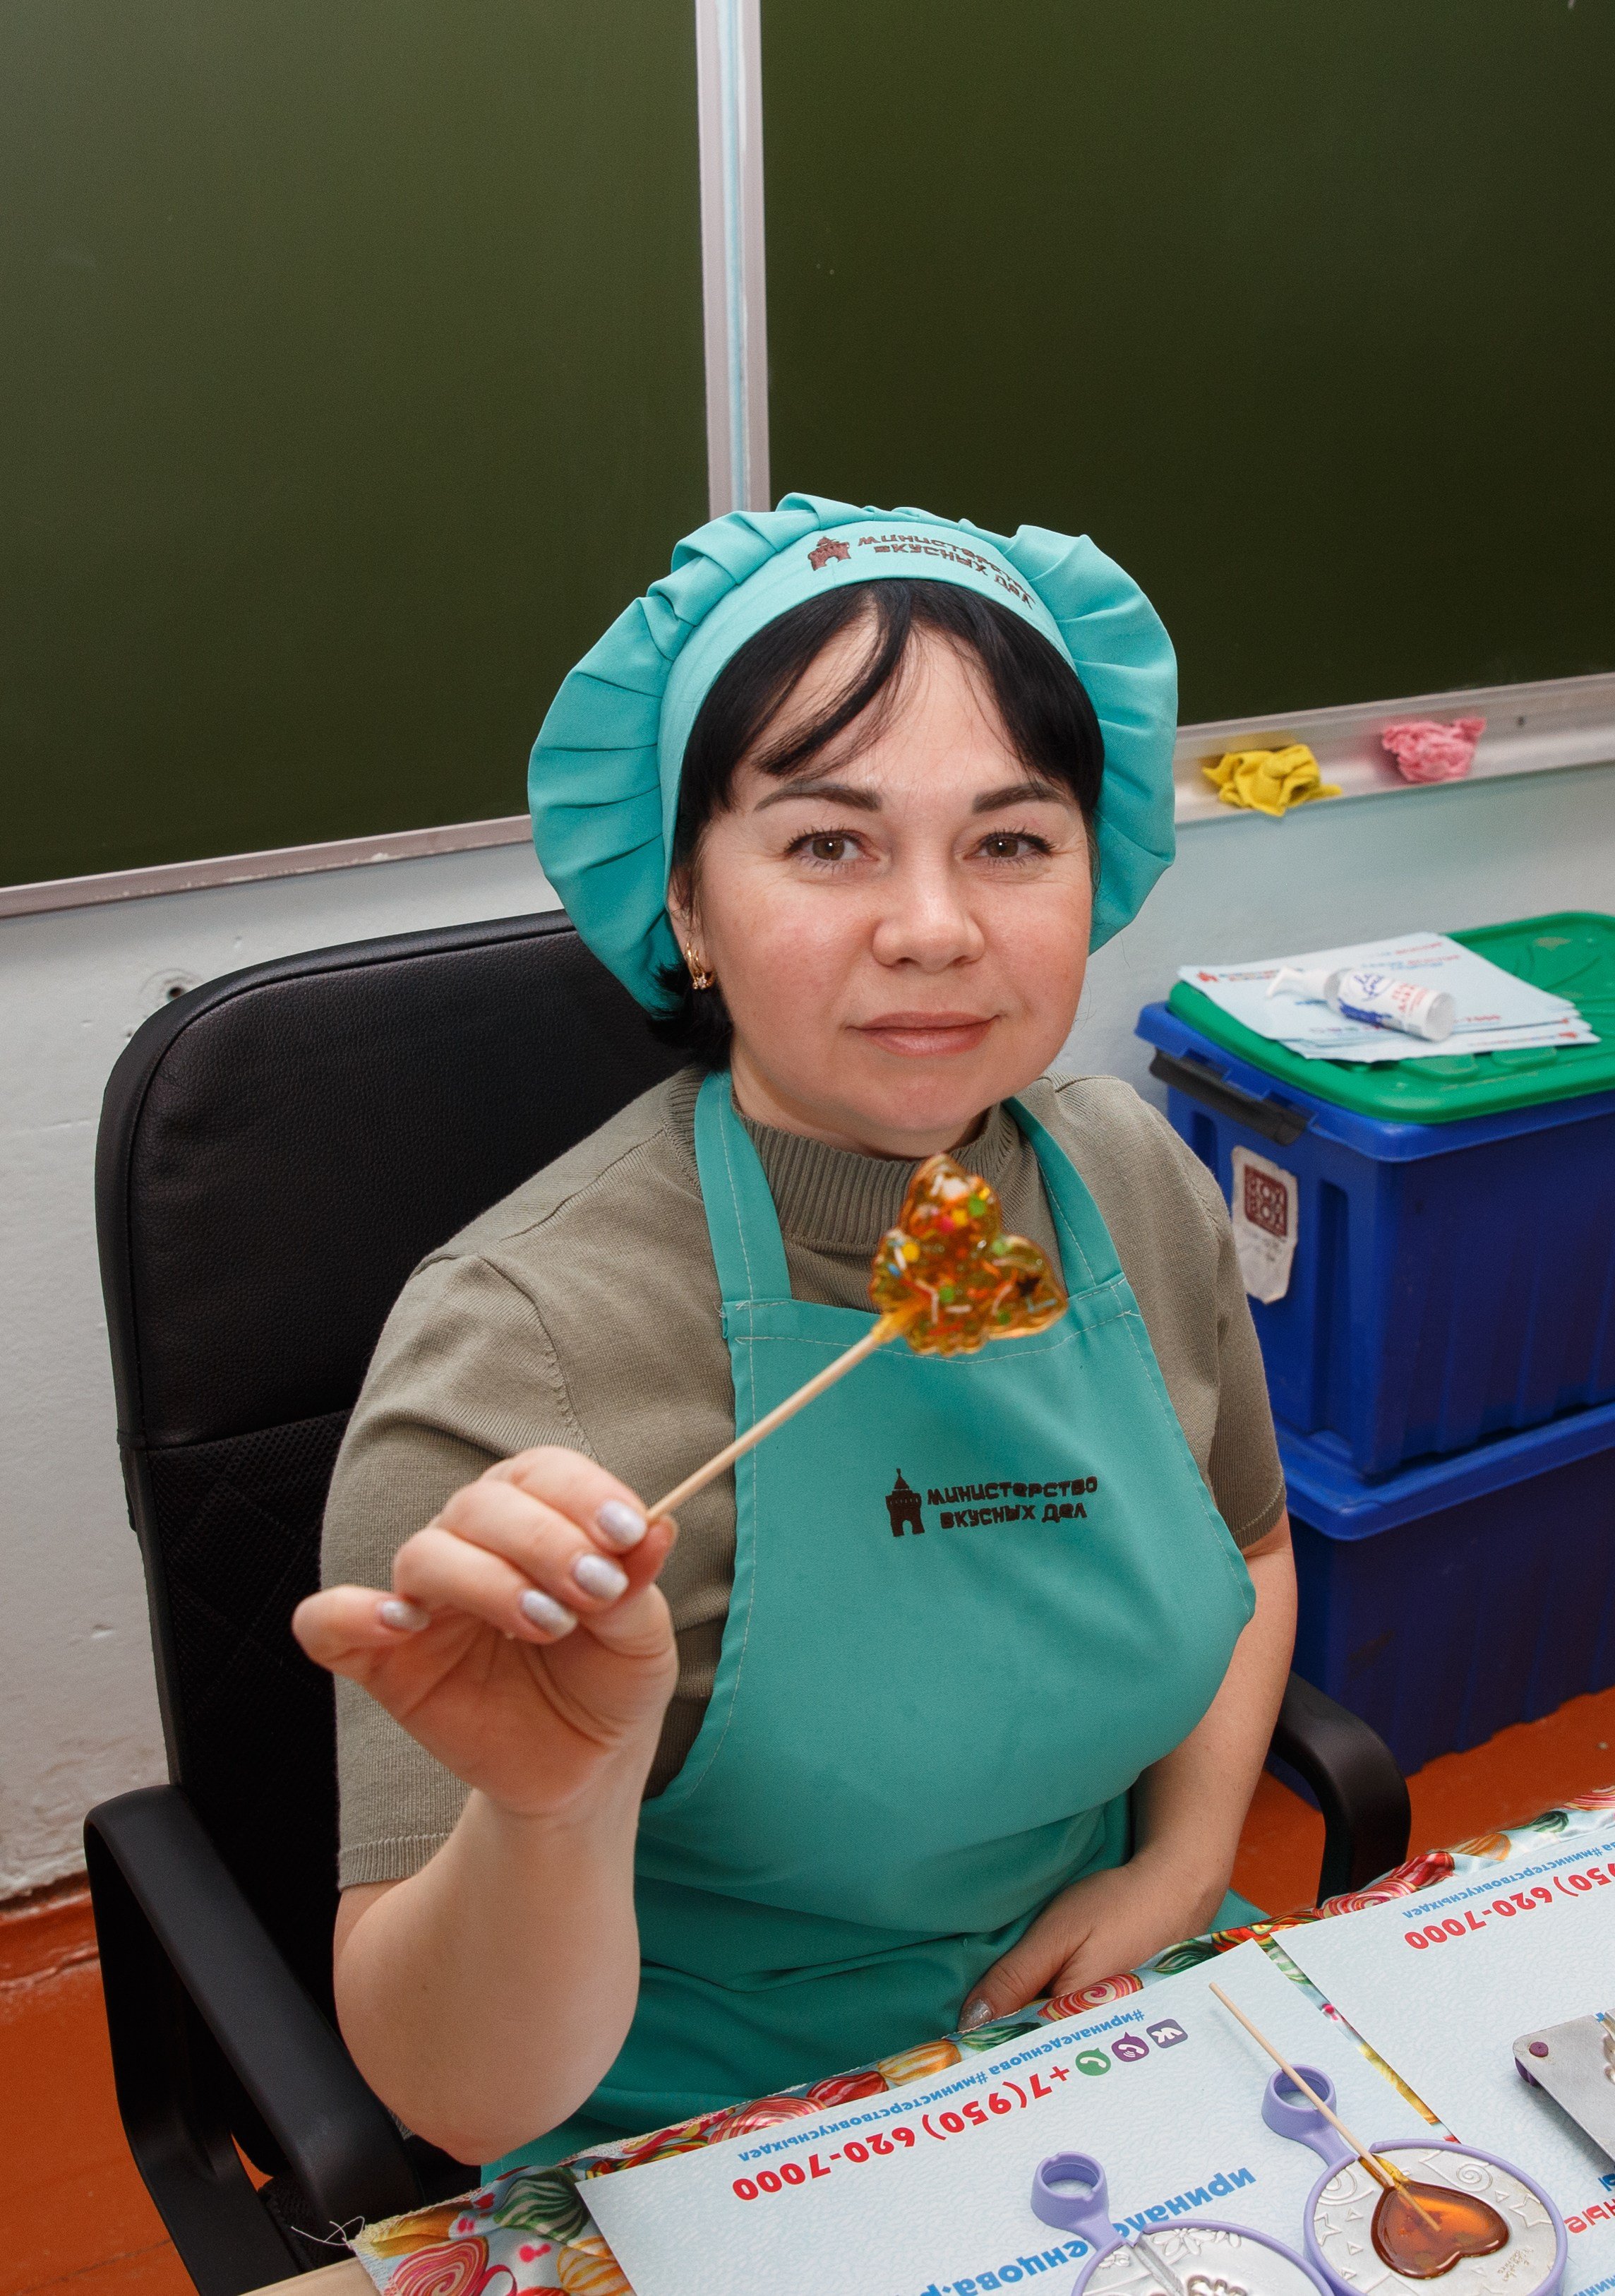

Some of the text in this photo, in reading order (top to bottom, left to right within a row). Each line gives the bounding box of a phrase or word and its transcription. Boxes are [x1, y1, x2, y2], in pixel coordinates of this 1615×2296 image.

[874, 544, 988, 576] ВКУСНЫХ
[927, 1476, 1098, 1505] МИНИСТЕРСТВО
[939, 1502, 1088, 1529] ВКУСНЫХ ДЕЛ
[1402, 1847, 1604, 1919] #министерствовкусныхдел
[1404, 1887, 1553, 1950] 620-7000
[738, 2009, 1145, 2162] #ириналеденцова #министерствовкусныхдел
[732, 2066, 1071, 2201] +7(950) 620-7000
